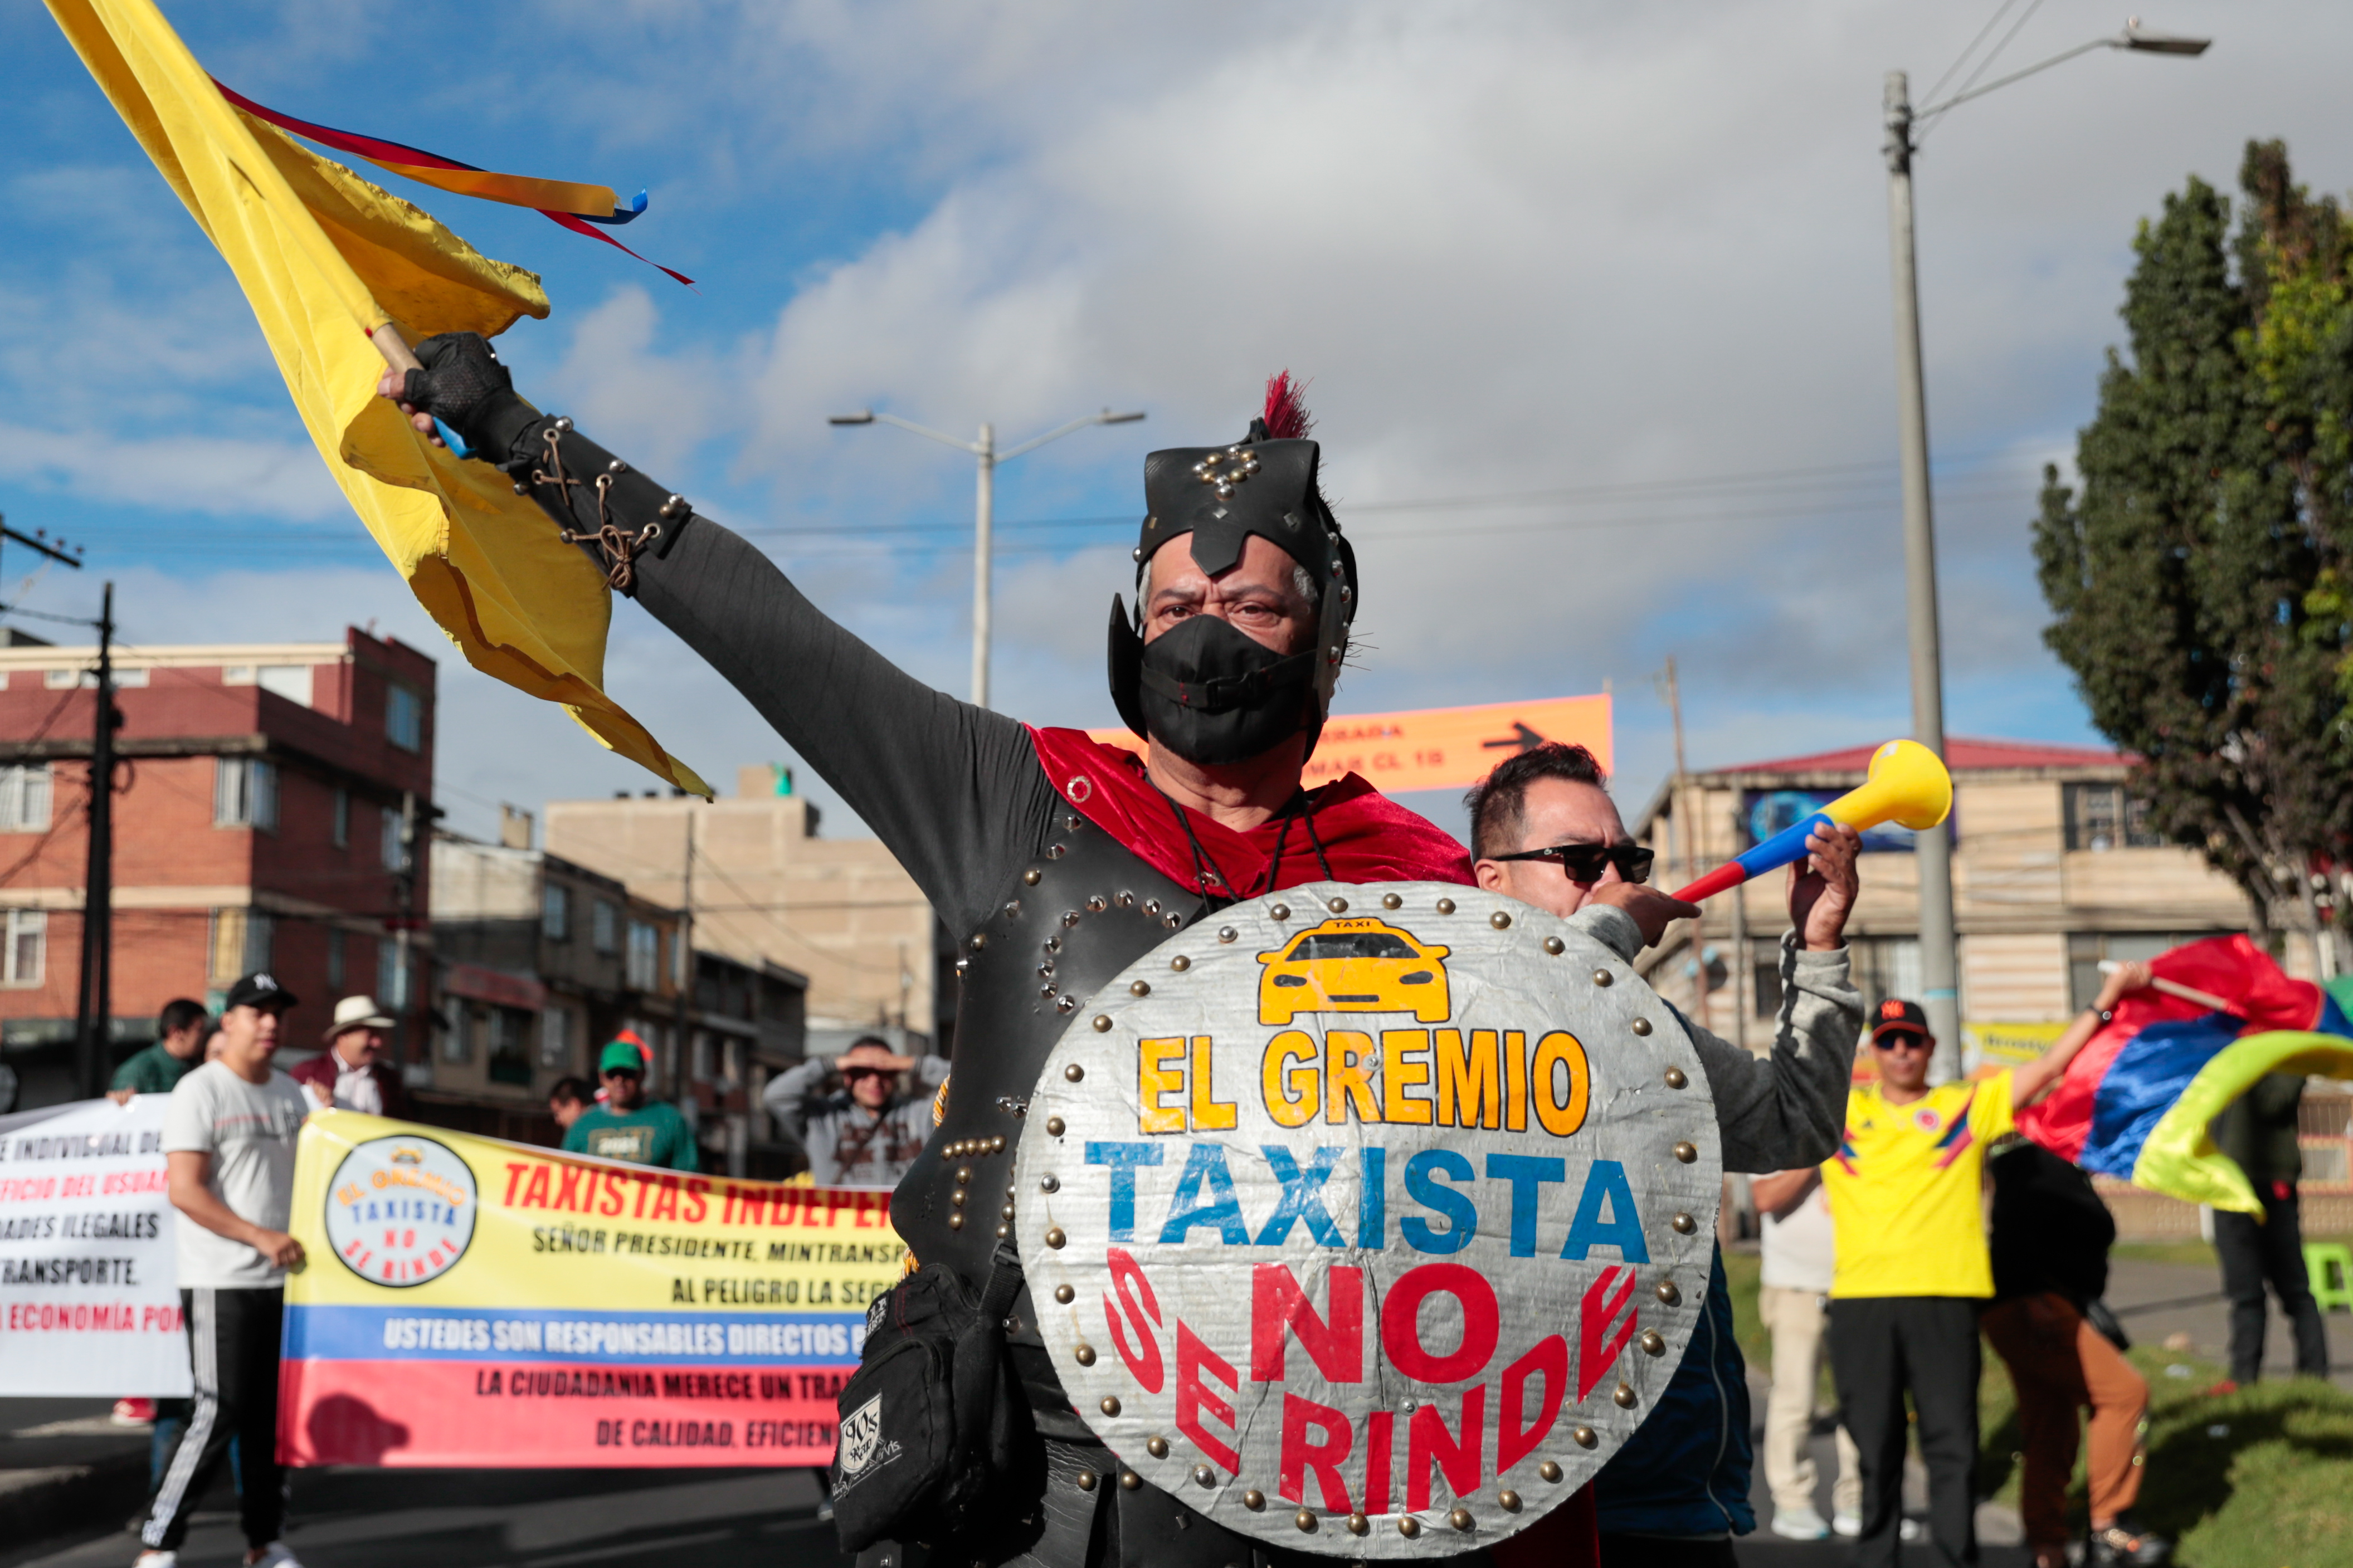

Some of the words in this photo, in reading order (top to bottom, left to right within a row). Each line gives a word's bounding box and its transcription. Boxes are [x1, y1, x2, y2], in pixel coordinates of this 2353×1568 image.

[1137, 1035, 1238, 1135] EL
[1260, 1028, 1591, 1137] GREMIO
[14, 1132, 131, 1160] INDIVIDUAL
[61, 1175, 96, 1197] DEL
[336, 1181, 366, 1206] EL
[371, 1166, 466, 1206] GREMIO
[504, 1162, 708, 1223] TAXISTAS
[352, 1199, 456, 1225] TAXISTA
[1084, 1141, 1650, 1264] TAXISTA
[62, 1213, 160, 1239] ILEGALES
[384, 1229, 416, 1248] NO
[534, 1222, 606, 1253] SEÑOR
[344, 1239, 373, 1270] SE
[382, 1237, 460, 1279] RINDE
[672, 1278, 695, 1303] AL
[704, 1278, 798, 1304] PELIGRO
[808, 1280, 832, 1304] LA
[10, 1298, 134, 1331] ECONOMÍA
[1250, 1263, 1499, 1385] NO
[383, 1317, 491, 1352] USTEDES
[492, 1319, 542, 1352] SON
[544, 1321, 725, 1356] RESPONSABLES
[727, 1322, 847, 1356] DIRECTOS
[476, 1370, 502, 1396] LA
[664, 1372, 756, 1399] MERECE
[761, 1374, 790, 1399] UN
[1102, 1248, 1240, 1477] SE
[1278, 1265, 1639, 1516] RINDE
[596, 1419, 625, 1446] DE
